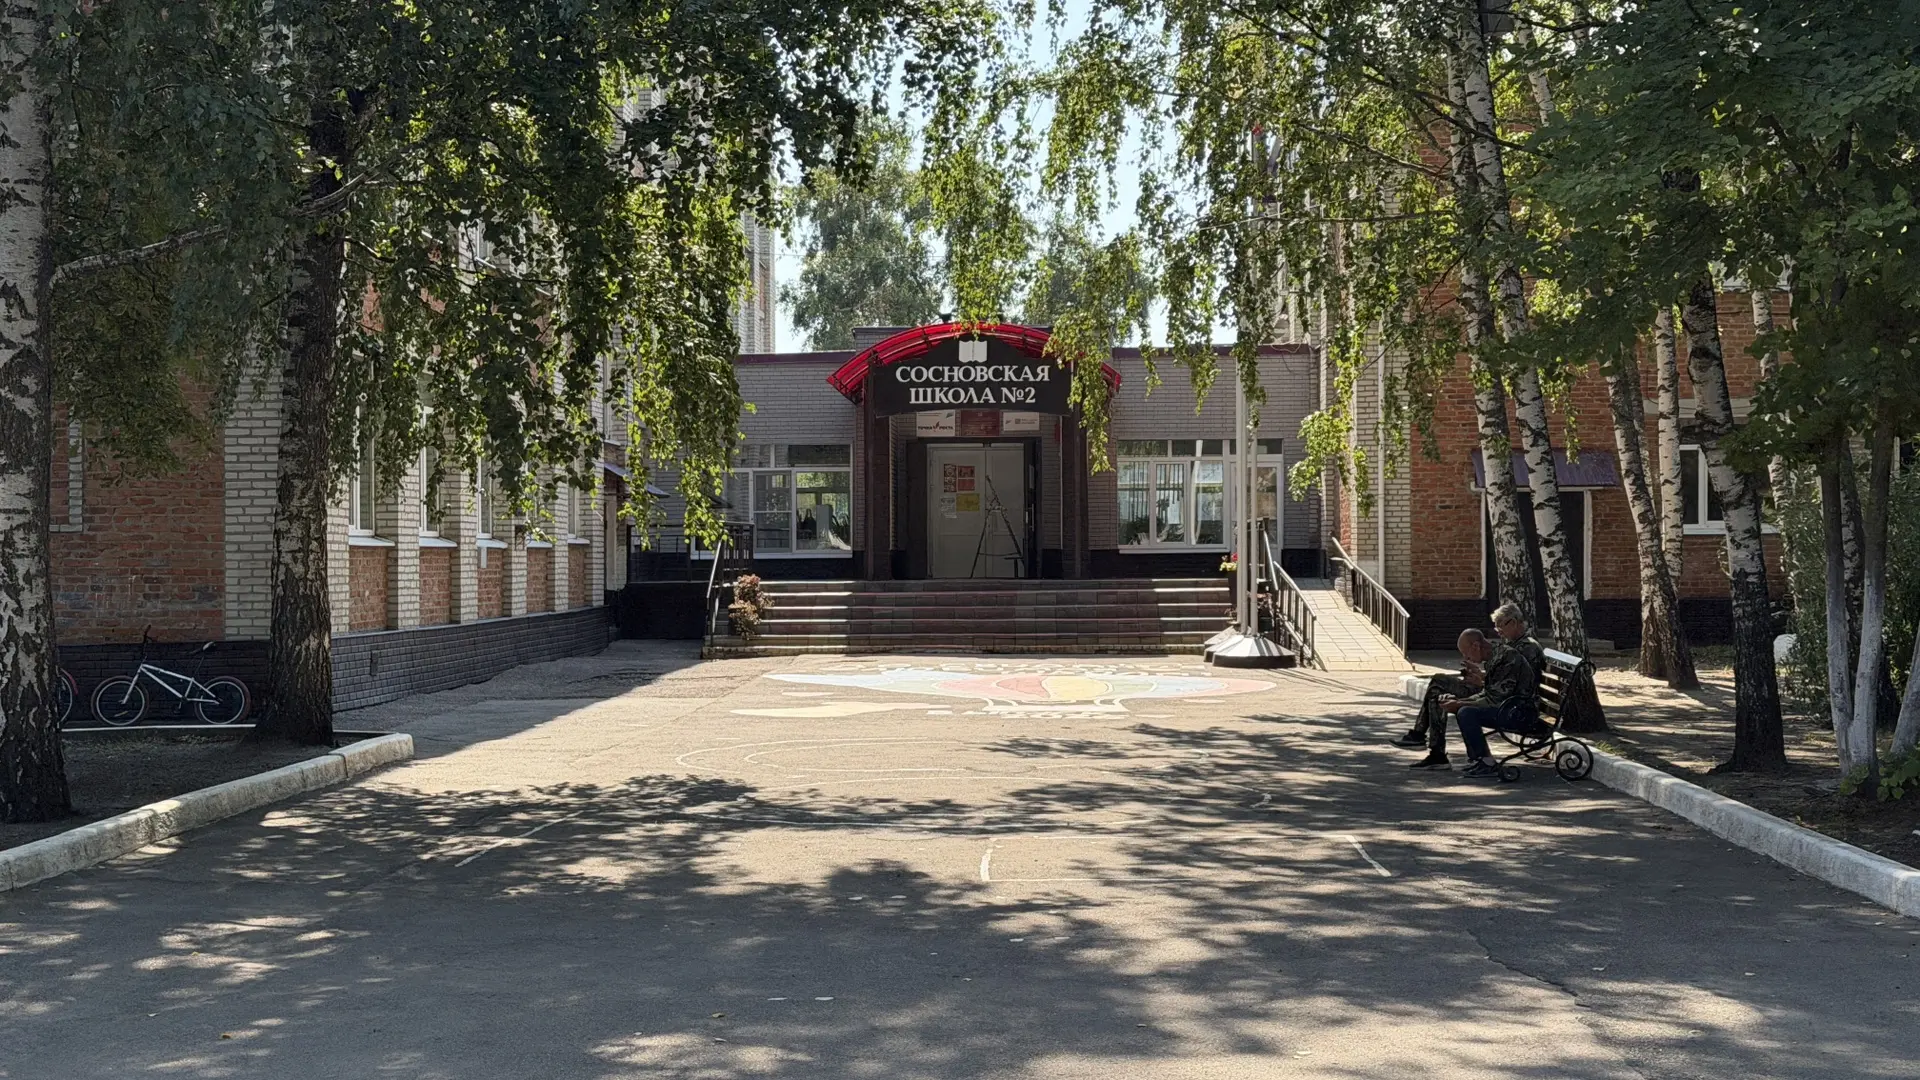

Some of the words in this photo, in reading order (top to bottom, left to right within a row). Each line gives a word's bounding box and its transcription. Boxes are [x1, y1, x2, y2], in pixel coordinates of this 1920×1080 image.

[895, 365, 1050, 382] СОСНОВСКАЯ
[909, 387, 996, 404] ШКОЛА
[1001, 387, 1036, 404] №2
